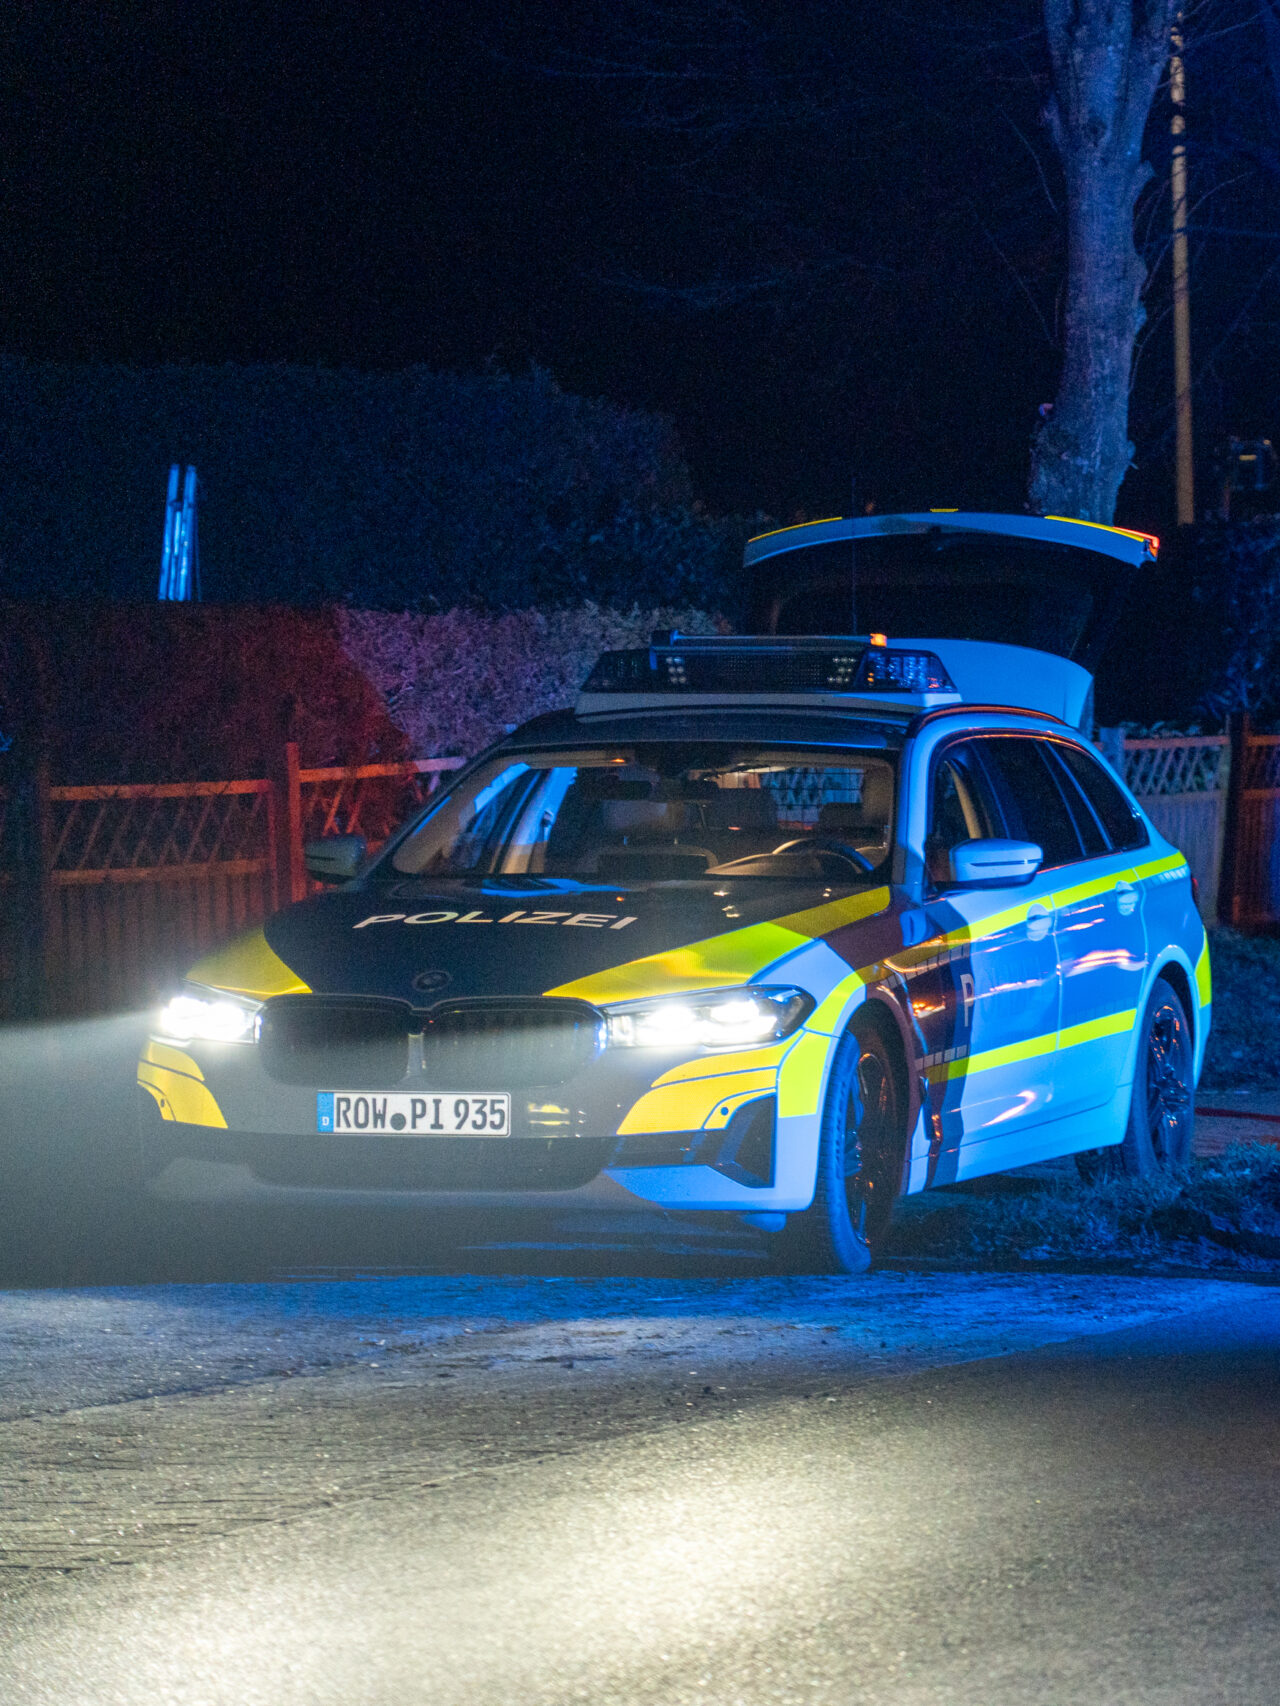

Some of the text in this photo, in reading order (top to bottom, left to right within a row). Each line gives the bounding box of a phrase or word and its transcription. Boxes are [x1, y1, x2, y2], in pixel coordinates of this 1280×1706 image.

[352, 910, 639, 930] POLIZEI
[321, 1116, 330, 1126] D
[336, 1097, 506, 1131] ROW PI 935
